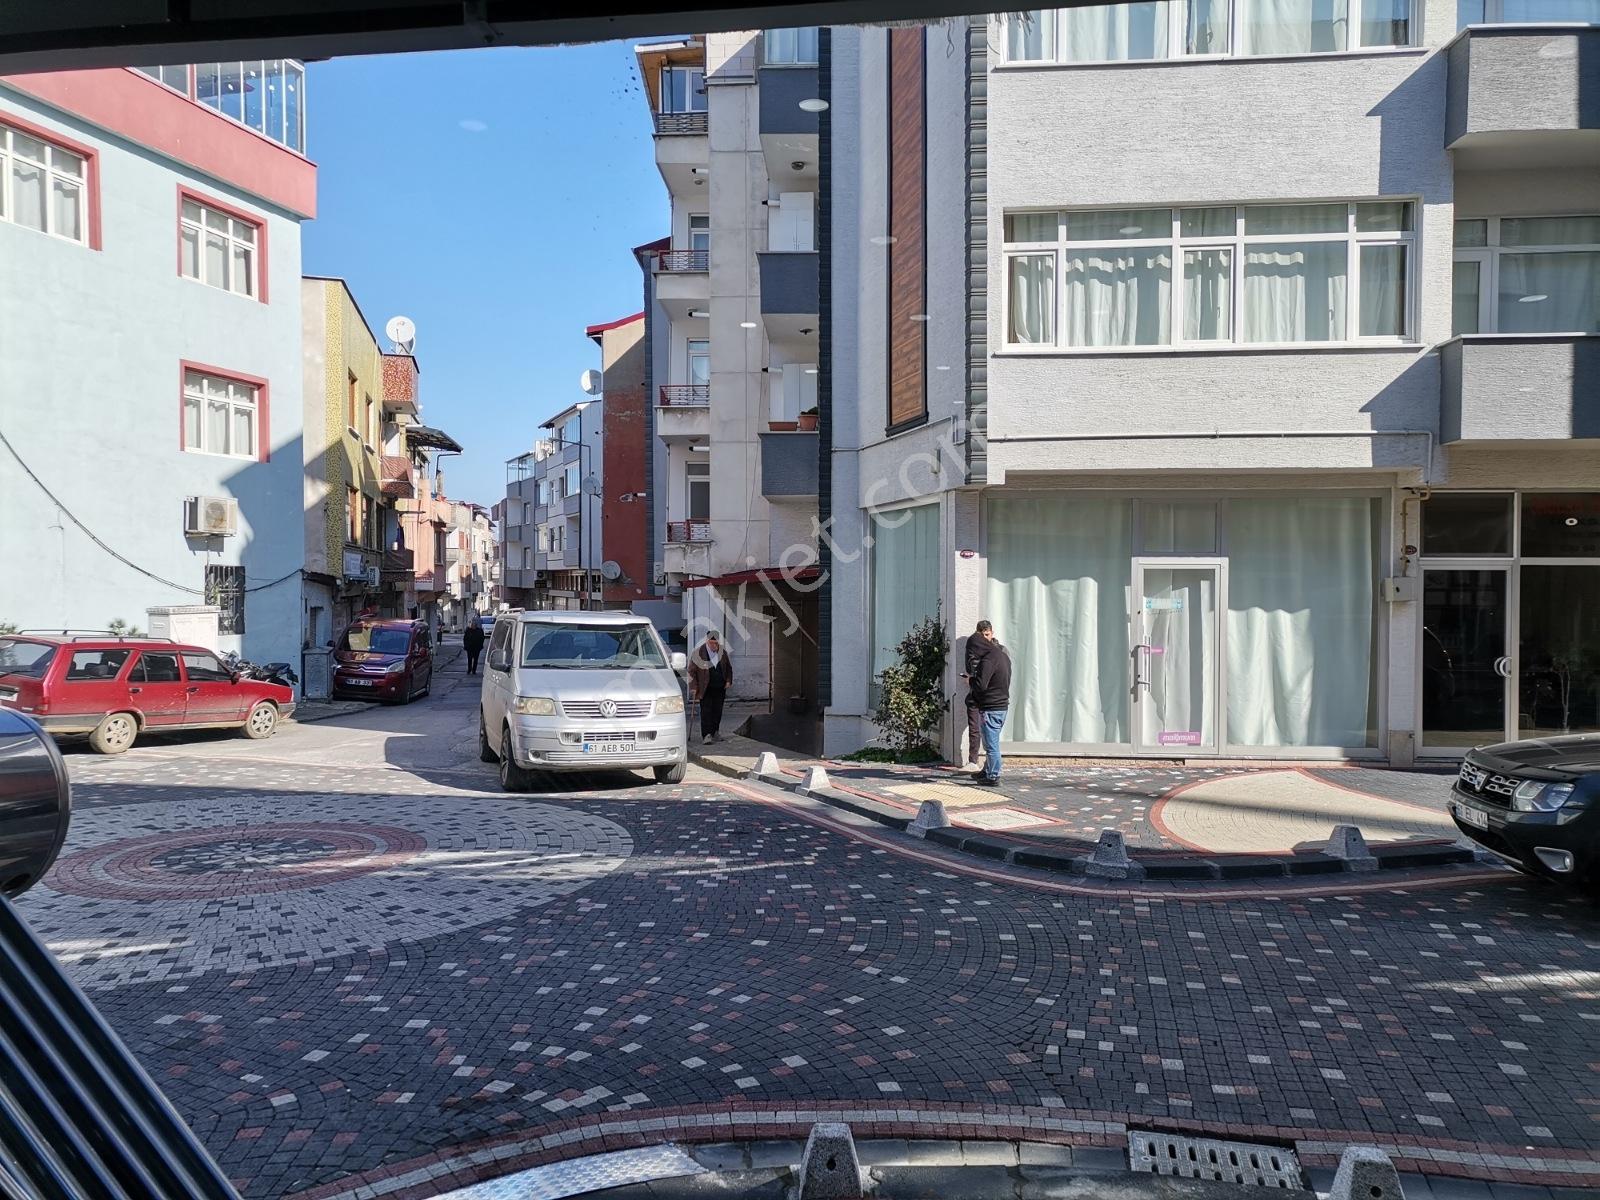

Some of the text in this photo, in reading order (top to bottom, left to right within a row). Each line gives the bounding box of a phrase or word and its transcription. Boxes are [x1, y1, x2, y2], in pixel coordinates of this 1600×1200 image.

[588, 743, 634, 752] 61 AEB 501
